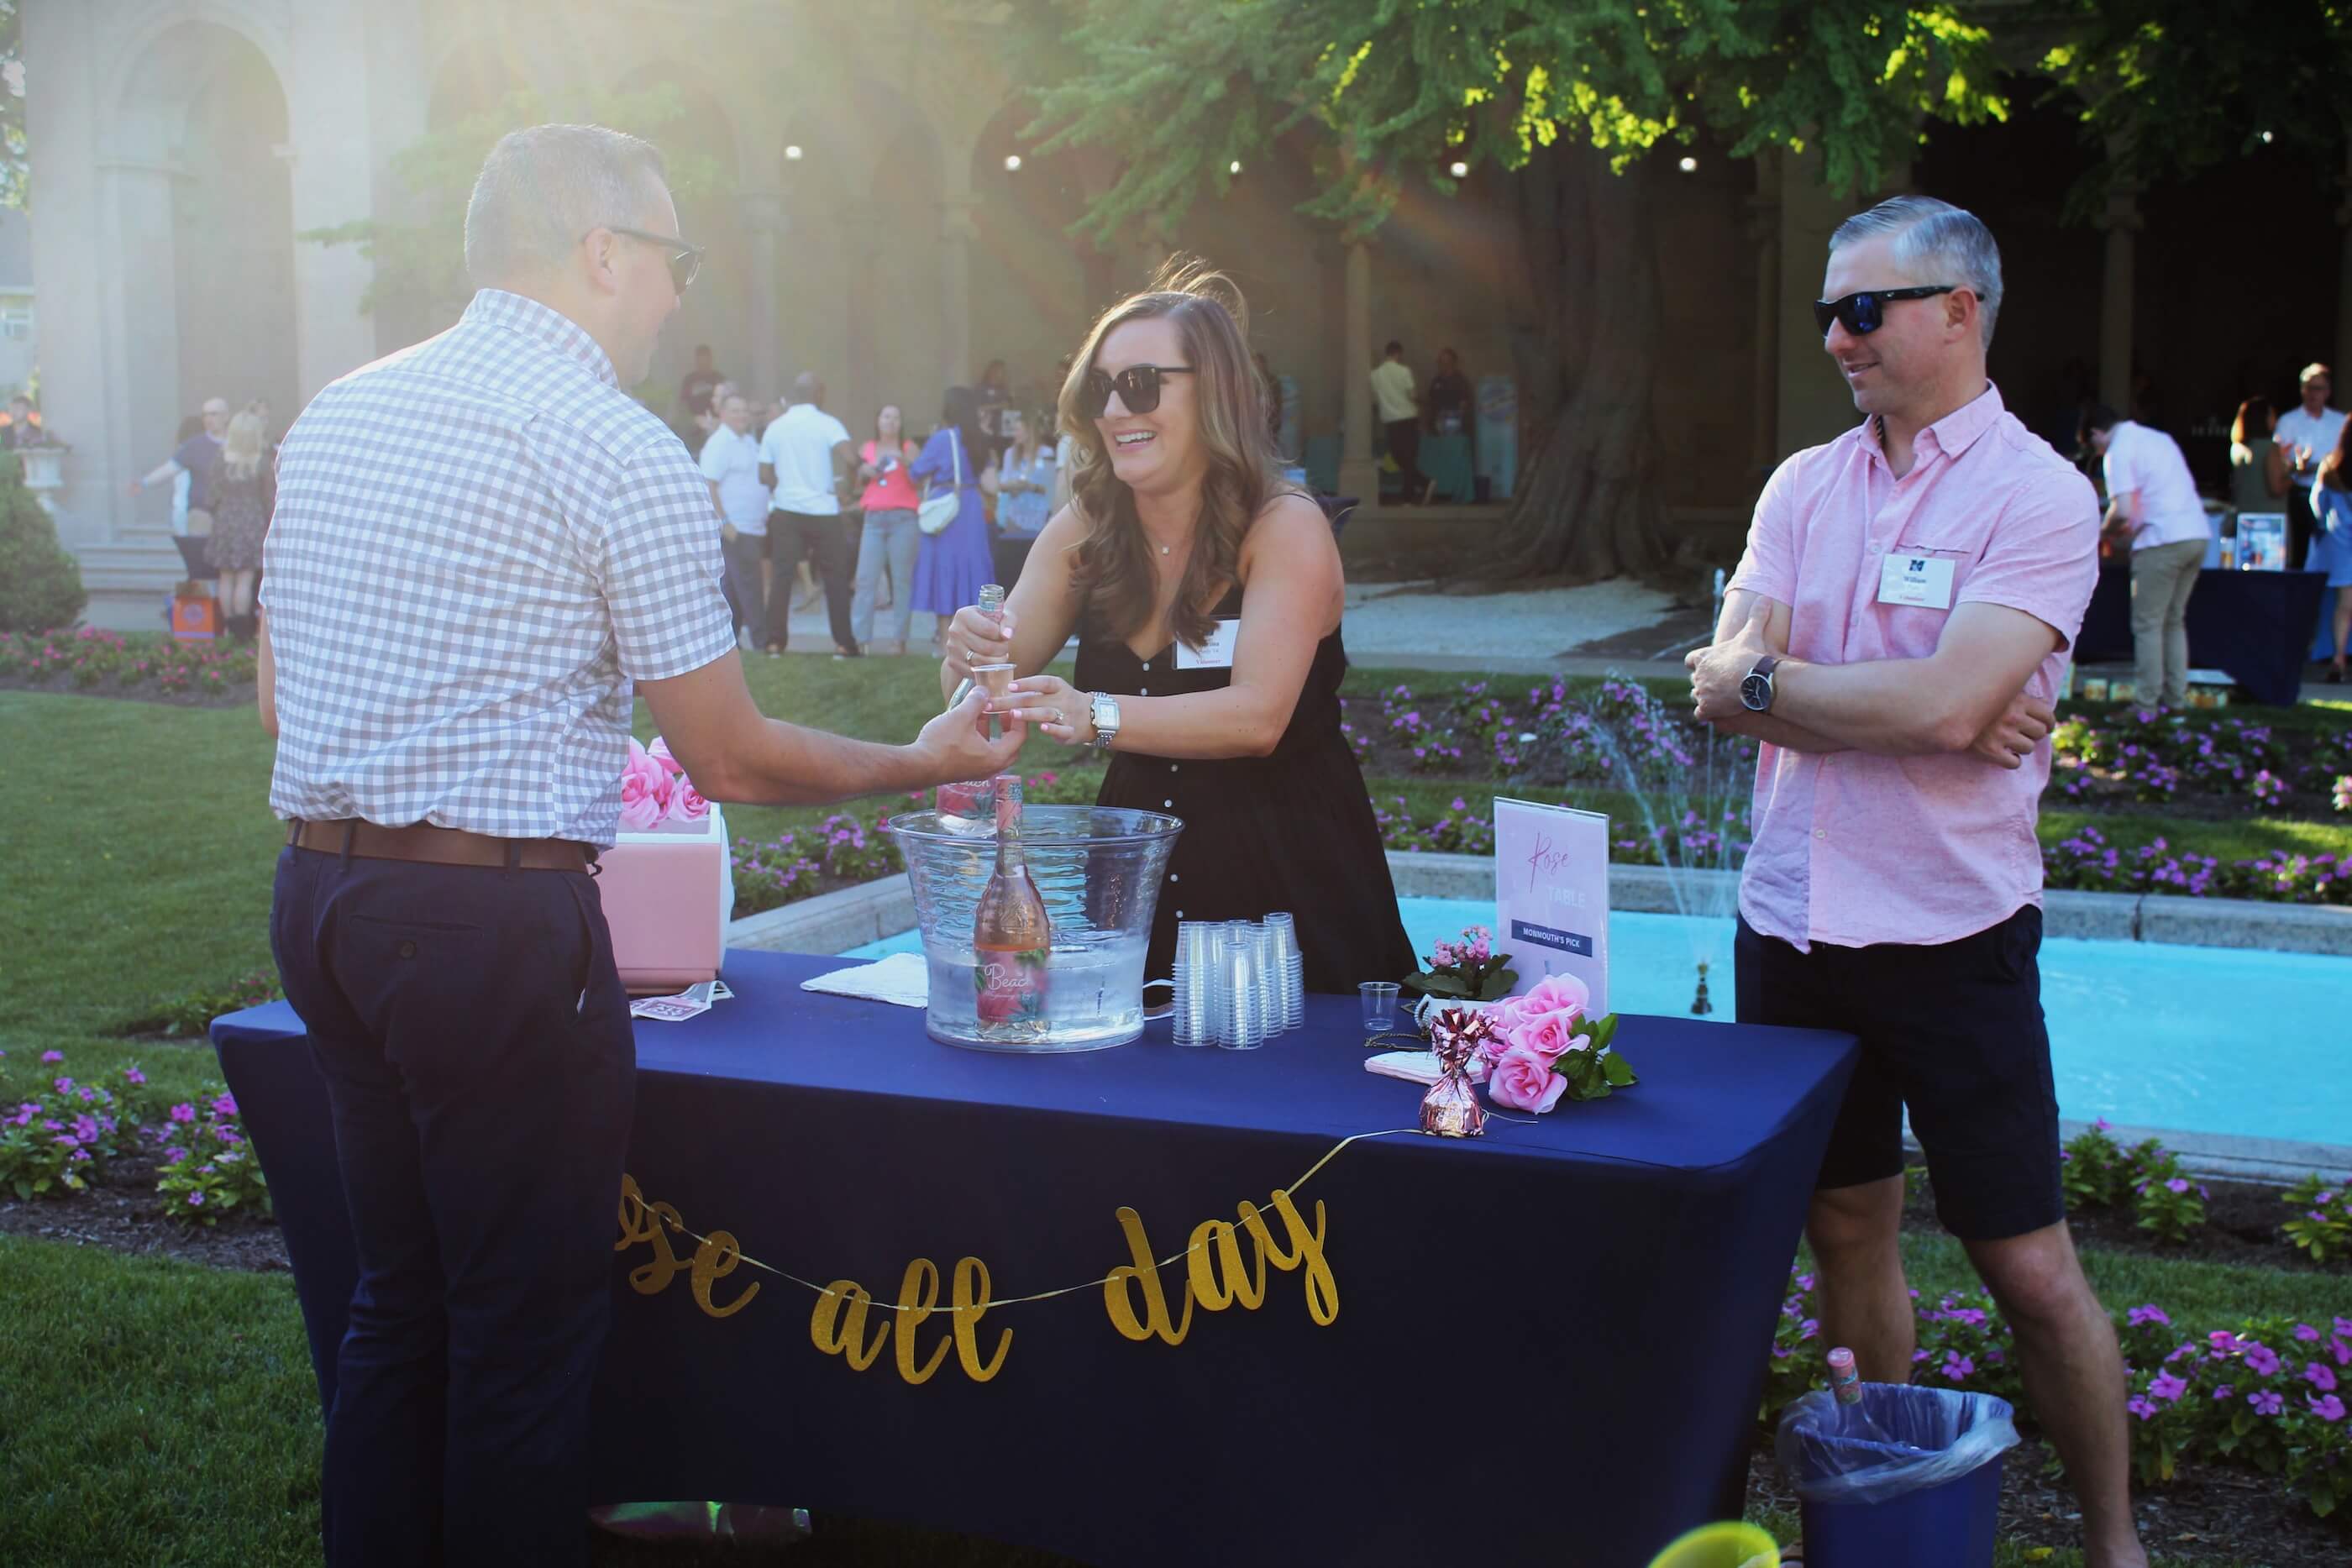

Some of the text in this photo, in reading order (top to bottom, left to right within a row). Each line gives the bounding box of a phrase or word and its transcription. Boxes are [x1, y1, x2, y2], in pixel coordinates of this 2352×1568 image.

[1547, 886, 1586, 908] TABLE
[1523, 927, 1580, 948] MONMOUTH'S PICK
[811, 1256, 1012, 1384] all
[1105, 1189, 1339, 1345] day
